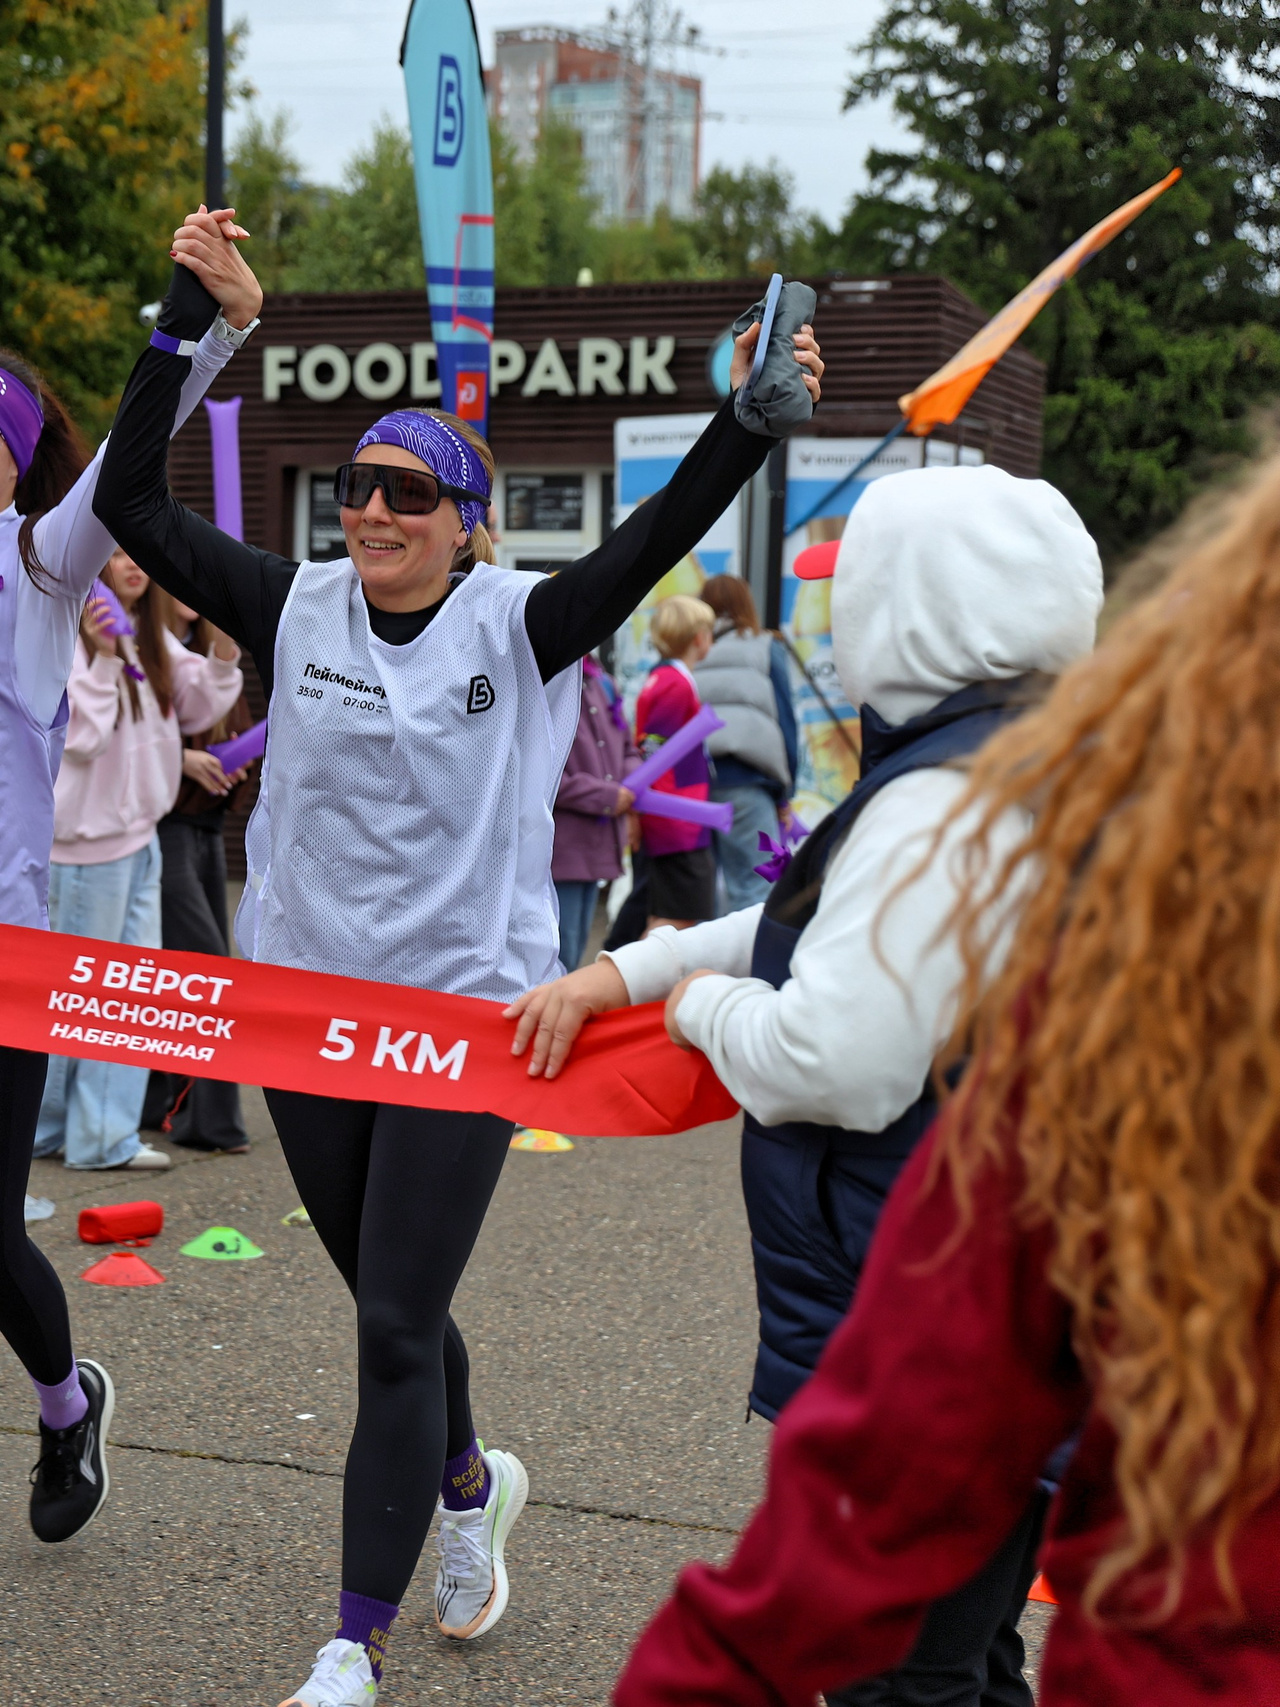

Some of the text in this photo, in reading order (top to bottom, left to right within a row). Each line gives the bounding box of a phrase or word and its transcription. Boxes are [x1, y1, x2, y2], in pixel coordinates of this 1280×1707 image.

[263, 342, 442, 402] FOOD
[489, 336, 677, 397] PARK
[297, 685, 324, 700] 35:00
[343, 696, 375, 711] 07:00
[69, 955, 233, 1006] 5 ВЁРСТ
[48, 990, 236, 1040] КРАСНОЯРСК
[50, 1022, 215, 1062] НАБЕРЕЖНАЯ
[318, 1018, 470, 1081] 5 КМ
